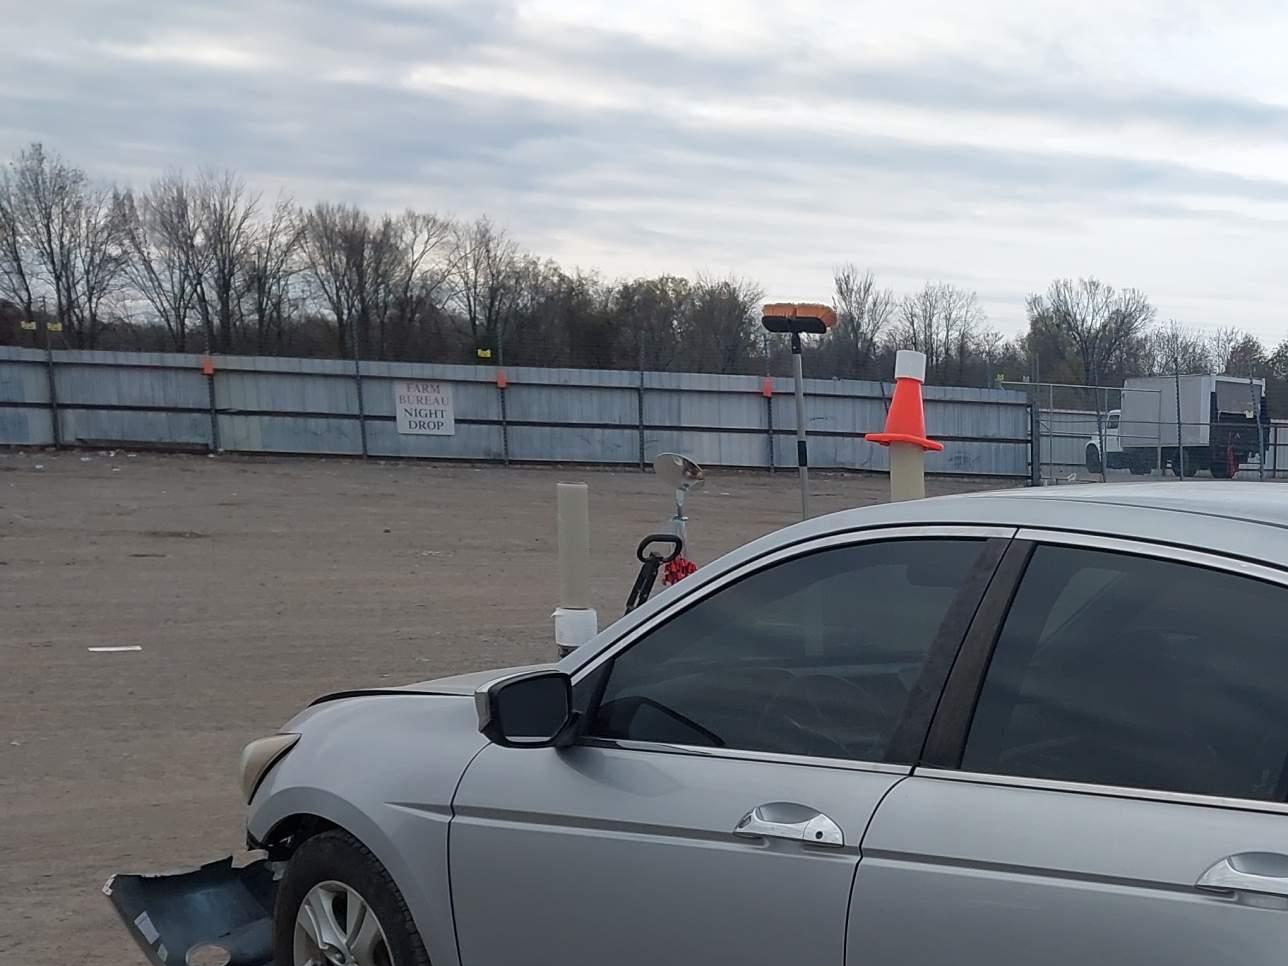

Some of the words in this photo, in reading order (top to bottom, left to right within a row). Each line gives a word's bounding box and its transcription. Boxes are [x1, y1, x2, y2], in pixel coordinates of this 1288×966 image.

[406, 383, 441, 394] FARM
[399, 395, 448, 406] BUREAU
[403, 407, 446, 419] NIGHT
[408, 420, 444, 431] DROP
